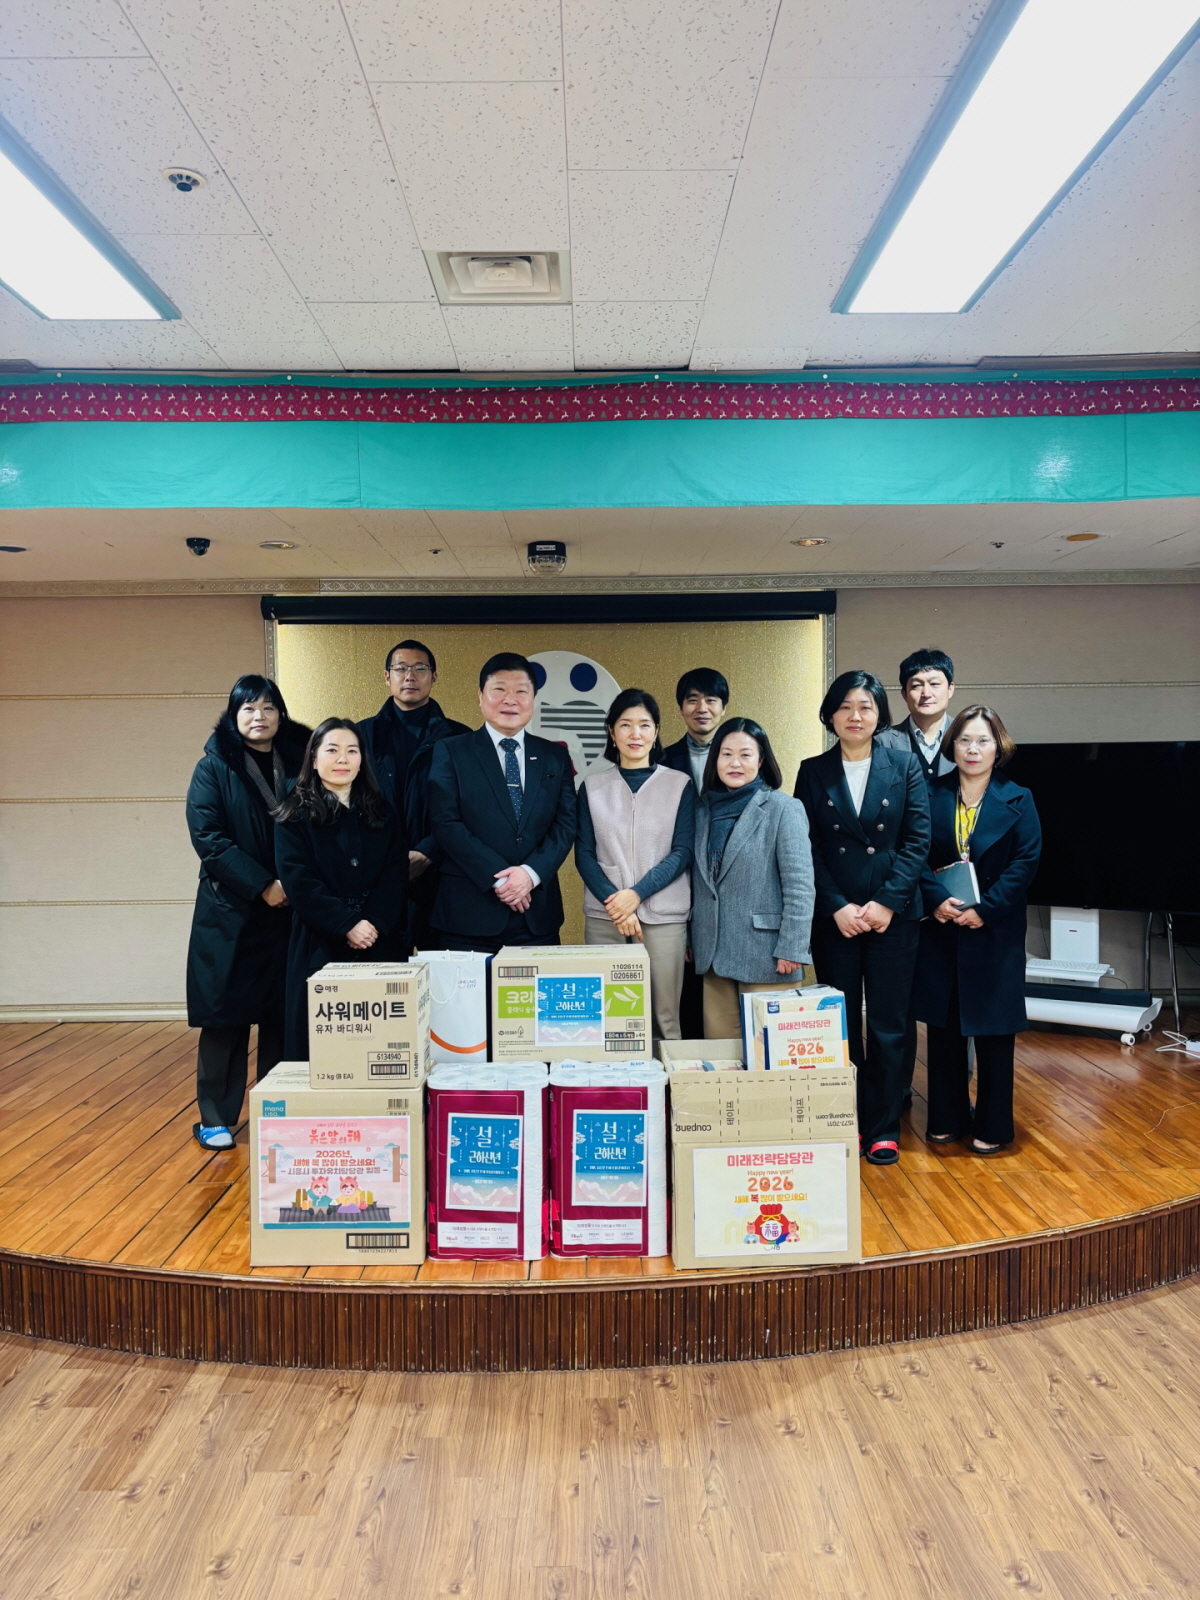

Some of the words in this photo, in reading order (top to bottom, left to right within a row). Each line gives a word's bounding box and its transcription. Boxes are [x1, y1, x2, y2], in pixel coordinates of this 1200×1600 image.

[324, 985, 338, 993] 애경
[561, 983, 576, 999] 설
[505, 991, 535, 1004] 크리
[315, 1000, 407, 1021] 샤워메이트
[555, 1001, 585, 1011] 근하신년
[315, 1024, 333, 1034] 유자
[337, 1023, 372, 1034] 바디워시
[777, 1019, 831, 1031] 미래전략담당관
[787, 1042, 824, 1057] 2026
[327, 1073, 335, 1081] kg
[726, 1100, 735, 1126] 테이프
[796, 1098, 804, 1123] 테이프
[816, 1112, 855, 1120] coupang.com
[601, 1121, 617, 1144] 설
[675, 1122, 712, 1132] coupang
[476, 1125, 492, 1148] 설
[468, 1150, 501, 1165] 근하신년
[594, 1146, 627, 1160] 근하신년
[727, 1151, 814, 1167] 미래전략담당관
[293, 1159, 309, 1167] 새해
[311, 1159, 319, 1167] 복
[321, 1159, 338, 1167] 많이
[340, 1158, 376, 1167] 받으세요!
[287, 1167, 310, 1175] 시흥시
[747, 1169, 766, 1177] Happy
[779, 1168, 794, 1176] year!
[747, 1176, 794, 1192] 2026
[734, 1195, 749, 1204] 새해
[751, 1194, 759, 1203] 복
[760, 1194, 775, 1203] 많이
[776, 1193, 808, 1202] 받으세요!
[764, 1223, 779, 1238] 福
